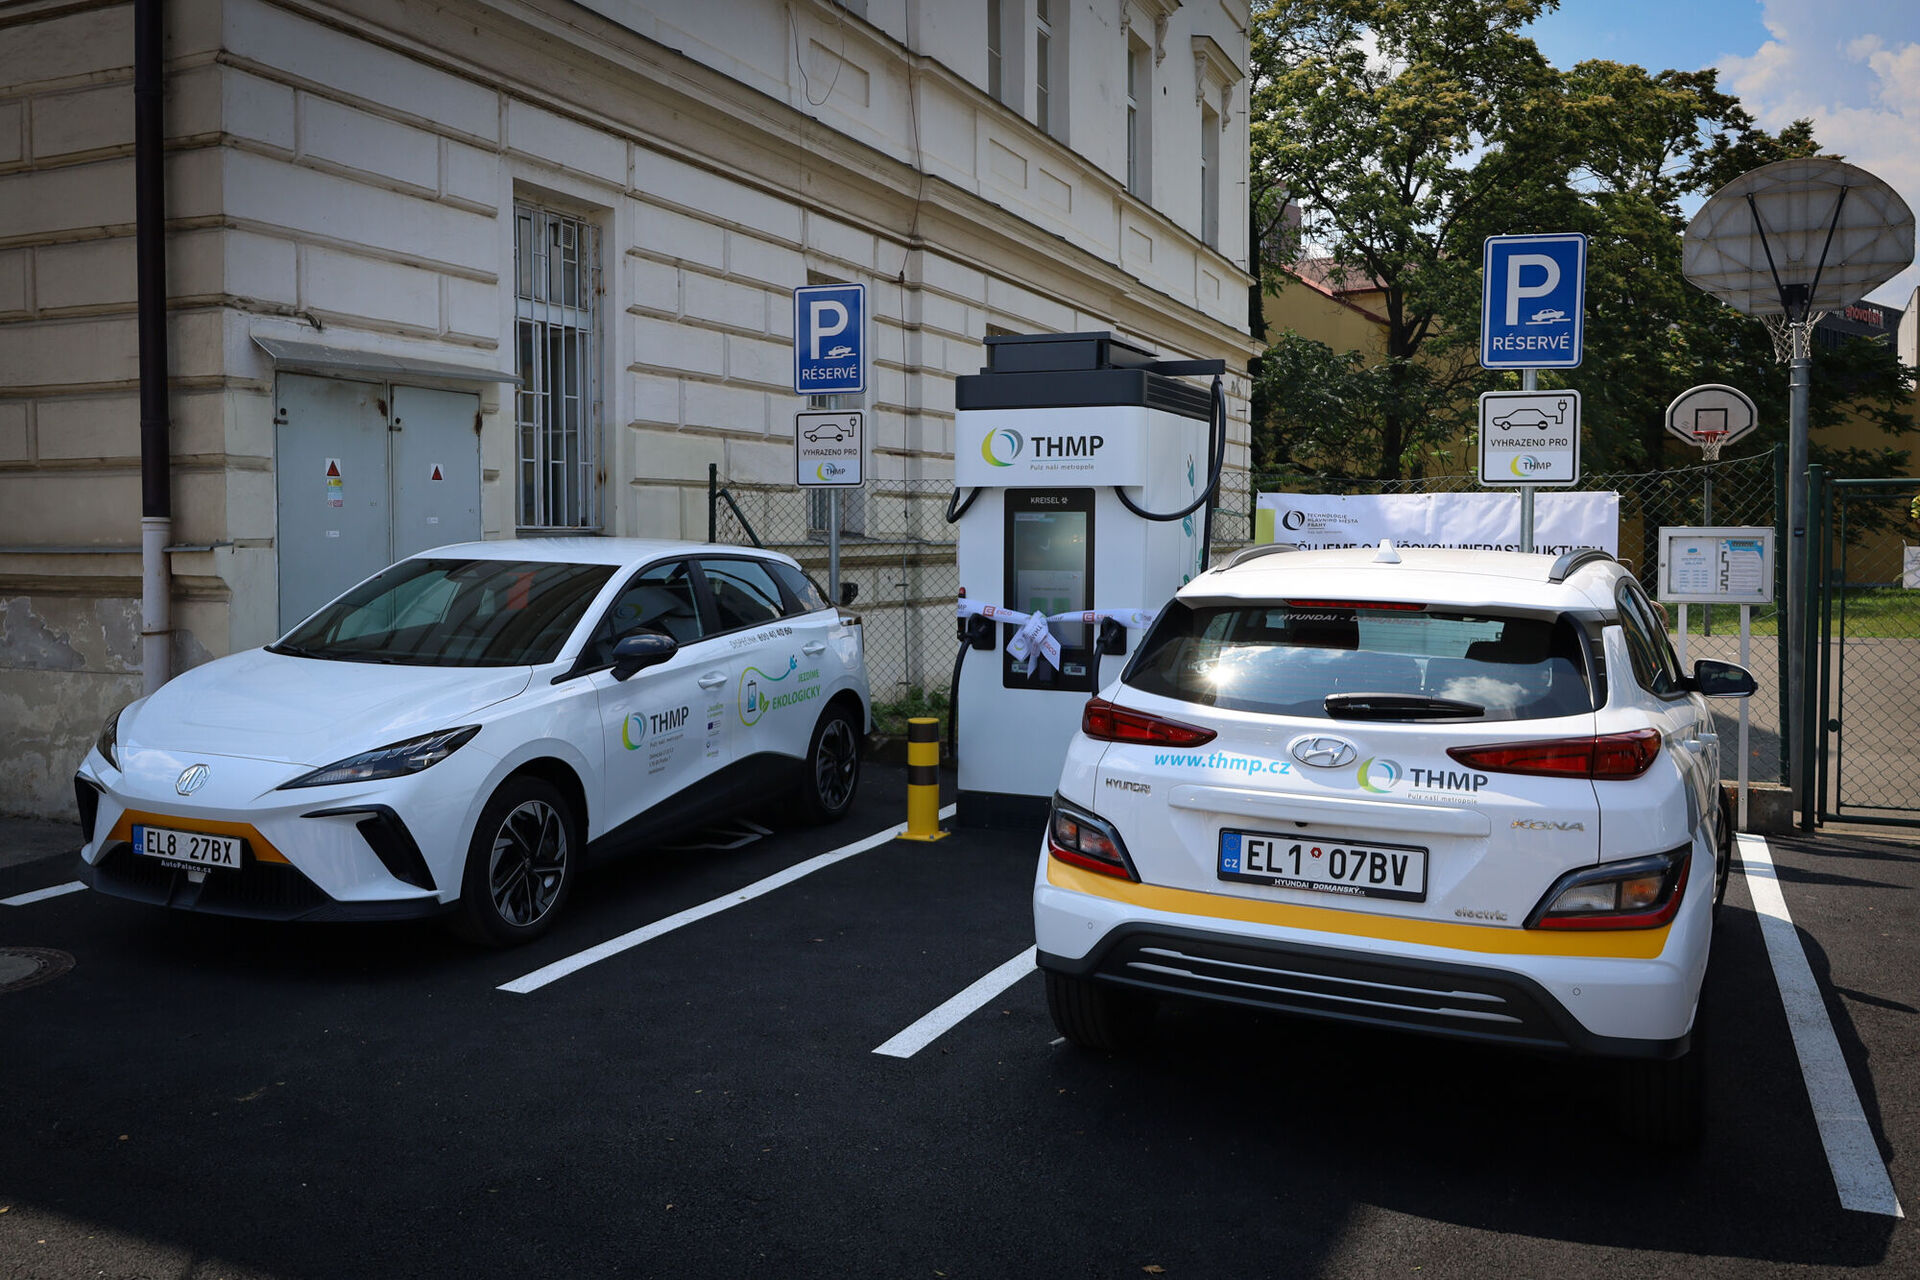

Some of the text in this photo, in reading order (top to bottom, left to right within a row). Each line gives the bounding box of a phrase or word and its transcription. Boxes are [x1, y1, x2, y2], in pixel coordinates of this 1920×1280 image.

[1505, 253, 1561, 326] P
[810, 300, 849, 360] P
[1492, 331, 1570, 350] RÉSERVÉ
[802, 363, 857, 380] RÉSERVÉ
[1030, 435, 1104, 457] THMP
[1490, 438, 1568, 447] VYHRAZENO PRO
[802, 448, 842, 456] VYHRAZENO
[826, 467, 846, 476] THMP
[1060, 463, 1095, 471] metropole
[1522, 461, 1552, 471] THMP
[1030, 496, 1060, 504] KREISEL
[1278, 613, 1337, 621] HYUNDAI
[772, 685, 821, 710] EKOLOGICKY
[650, 706, 689, 735] THMP
[1154, 752, 1292, 776] www.thmp.cz
[176, 763, 211, 796] MG
[1105, 777, 1151, 795] HYUNDAI
[1410, 768, 1489, 792] THMP
[1441, 796, 1478, 805] metropole
[1510, 818, 1585, 832] KONA
[134, 830, 232, 865] CZ EL8 27BX
[1224, 839, 1409, 886] CZ EL1 07BV
[1274, 878, 1310, 889] HYUNDAI
[1454, 907, 1508, 921] electric
